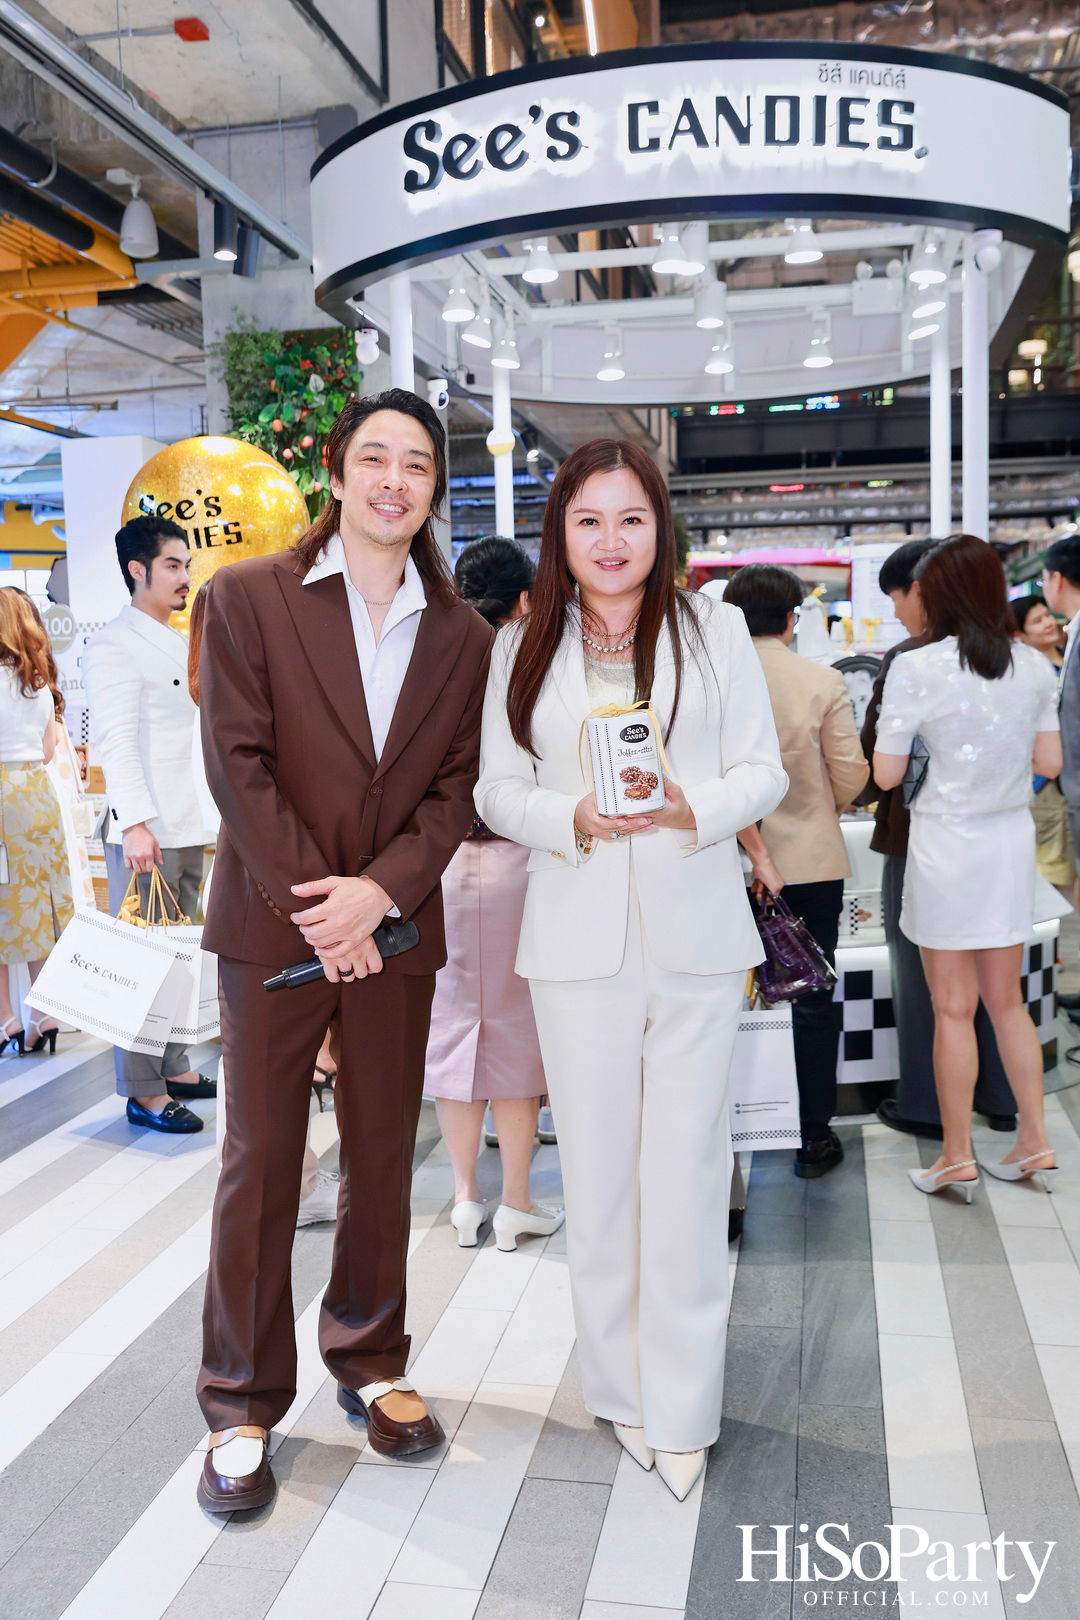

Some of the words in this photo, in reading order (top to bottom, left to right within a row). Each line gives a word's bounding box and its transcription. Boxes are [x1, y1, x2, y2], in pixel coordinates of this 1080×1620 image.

[403, 104, 583, 195] See's
[627, 94, 915, 154] CANDIES
[70, 953, 100, 973] See's
[102, 969, 139, 990] CANDIES
